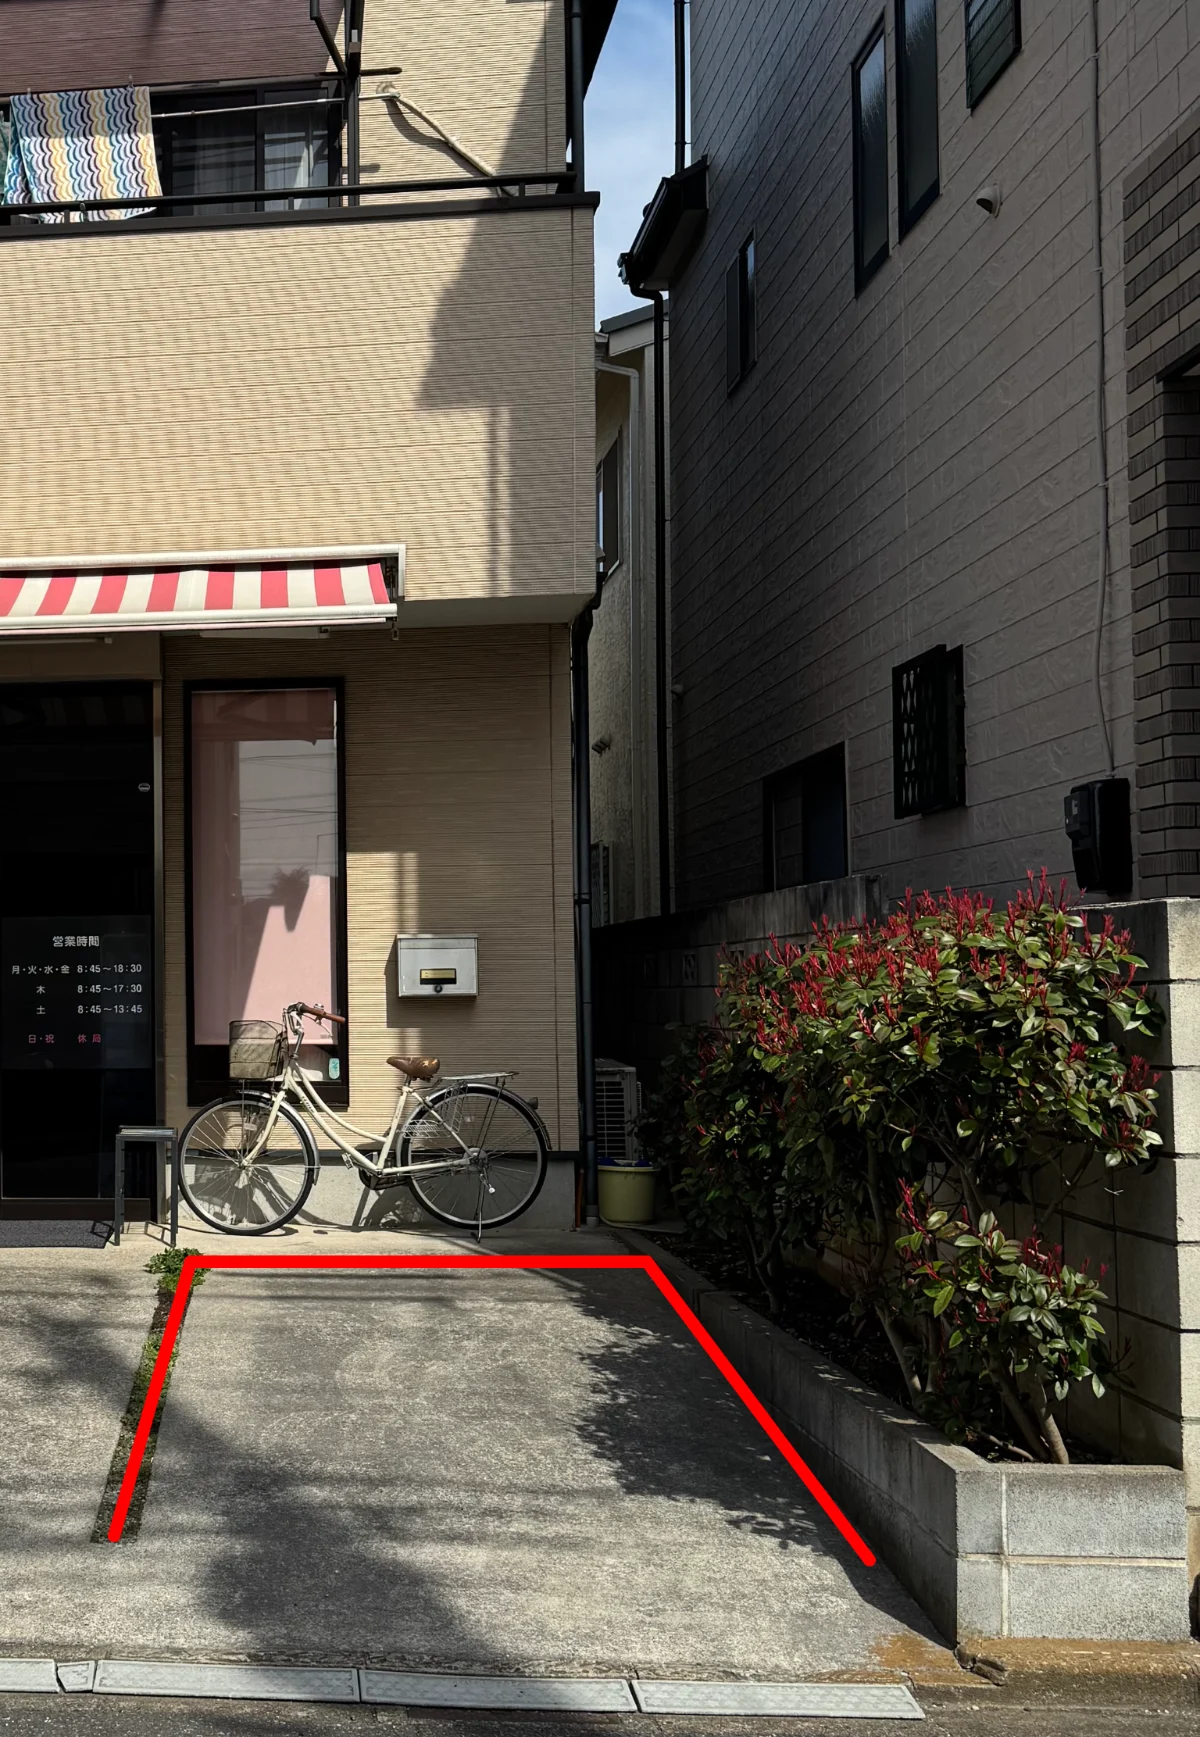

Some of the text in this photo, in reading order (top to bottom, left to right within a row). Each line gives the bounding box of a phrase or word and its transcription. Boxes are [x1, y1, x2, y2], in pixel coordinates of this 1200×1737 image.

[52, 935, 100, 947] 営業時間
[11, 965, 71, 975] 月・火・水・金
[36, 985, 46, 995] 木
[36, 1006, 46, 1015] 土
